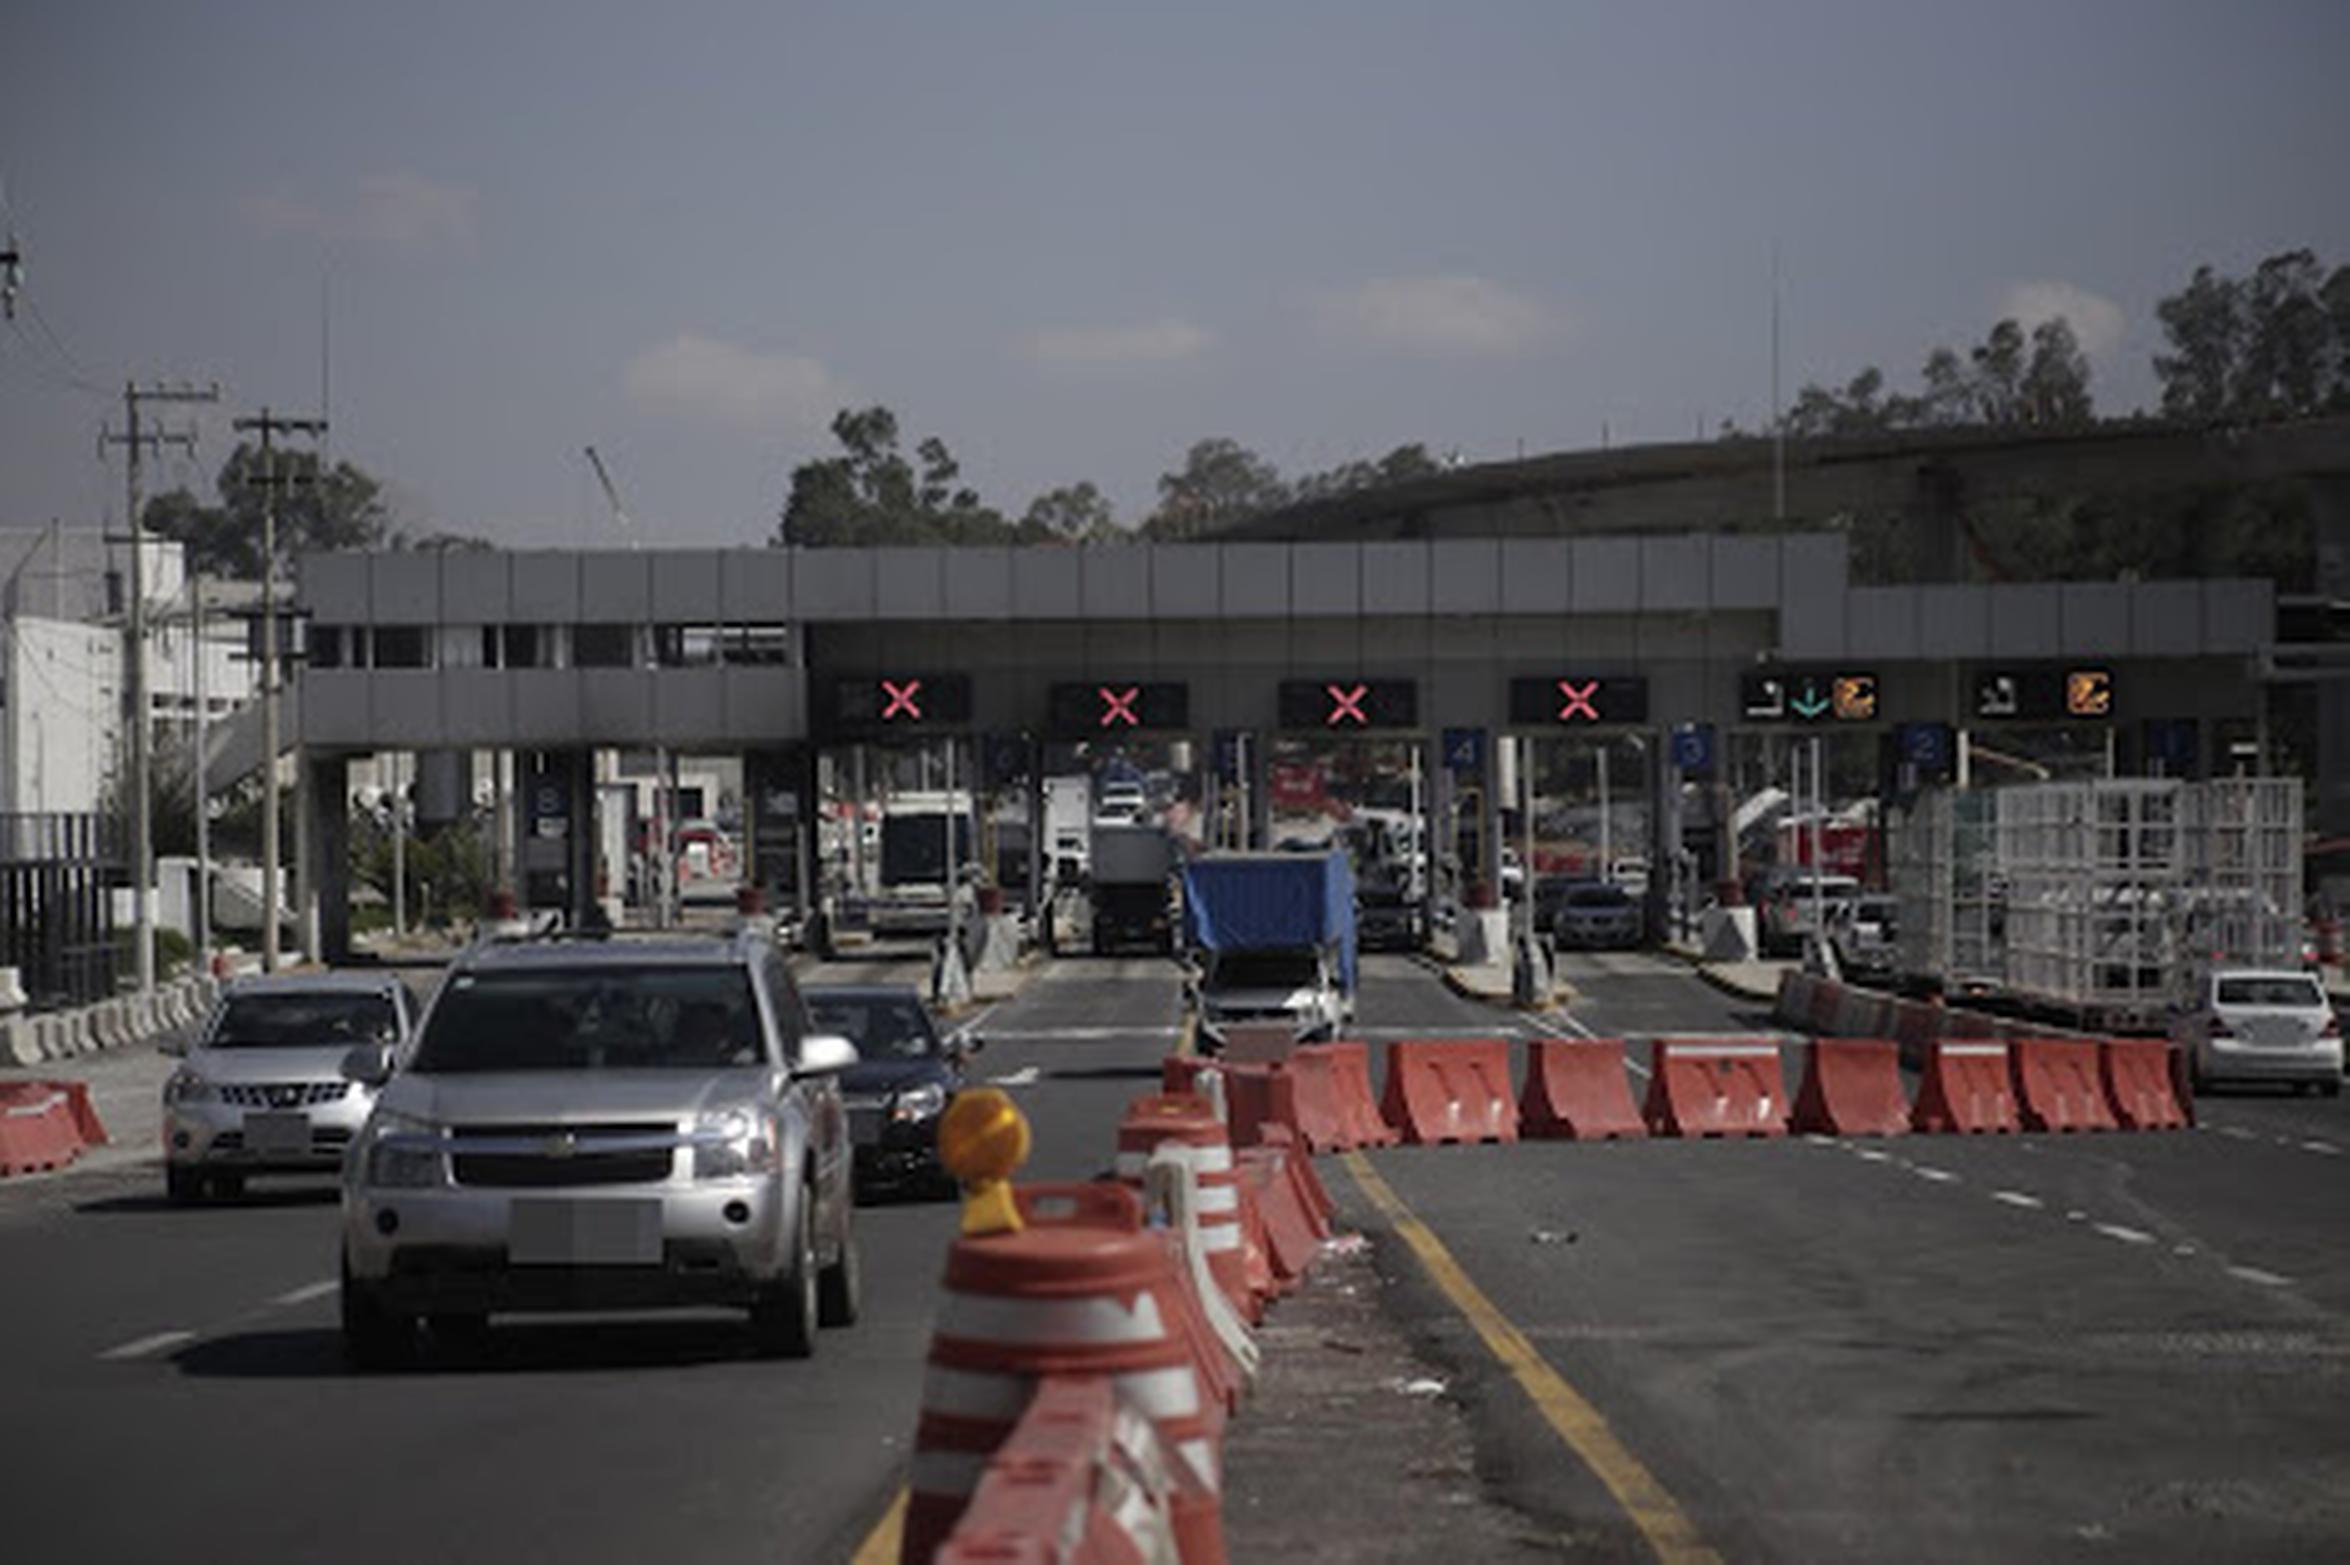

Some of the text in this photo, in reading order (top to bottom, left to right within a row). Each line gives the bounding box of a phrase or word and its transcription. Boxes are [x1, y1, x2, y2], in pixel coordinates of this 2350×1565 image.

[1452, 738, 1475, 763] 4
[1681, 737, 1704, 764] 3
[1911, 731, 1935, 760] 2
